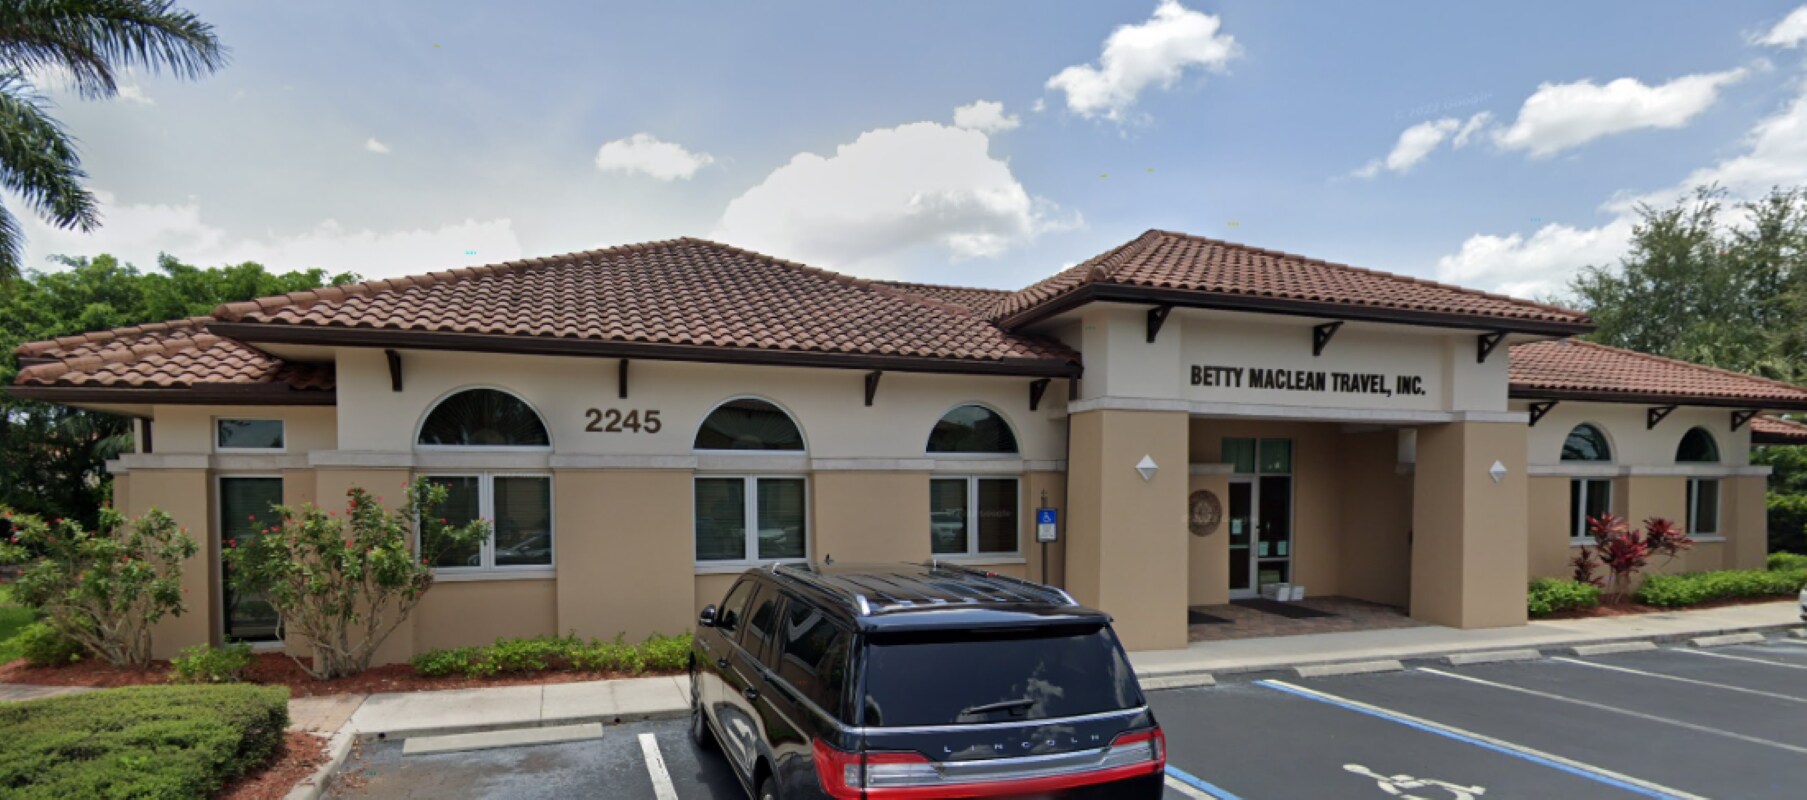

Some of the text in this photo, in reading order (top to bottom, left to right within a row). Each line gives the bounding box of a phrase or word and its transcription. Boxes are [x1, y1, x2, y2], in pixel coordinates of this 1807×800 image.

[1190, 365, 1427, 397] BETTY MACLEAN TRAVEL, INC.
[584, 407, 662, 434] 2245
[943, 734, 1100, 753] LINCOLN
